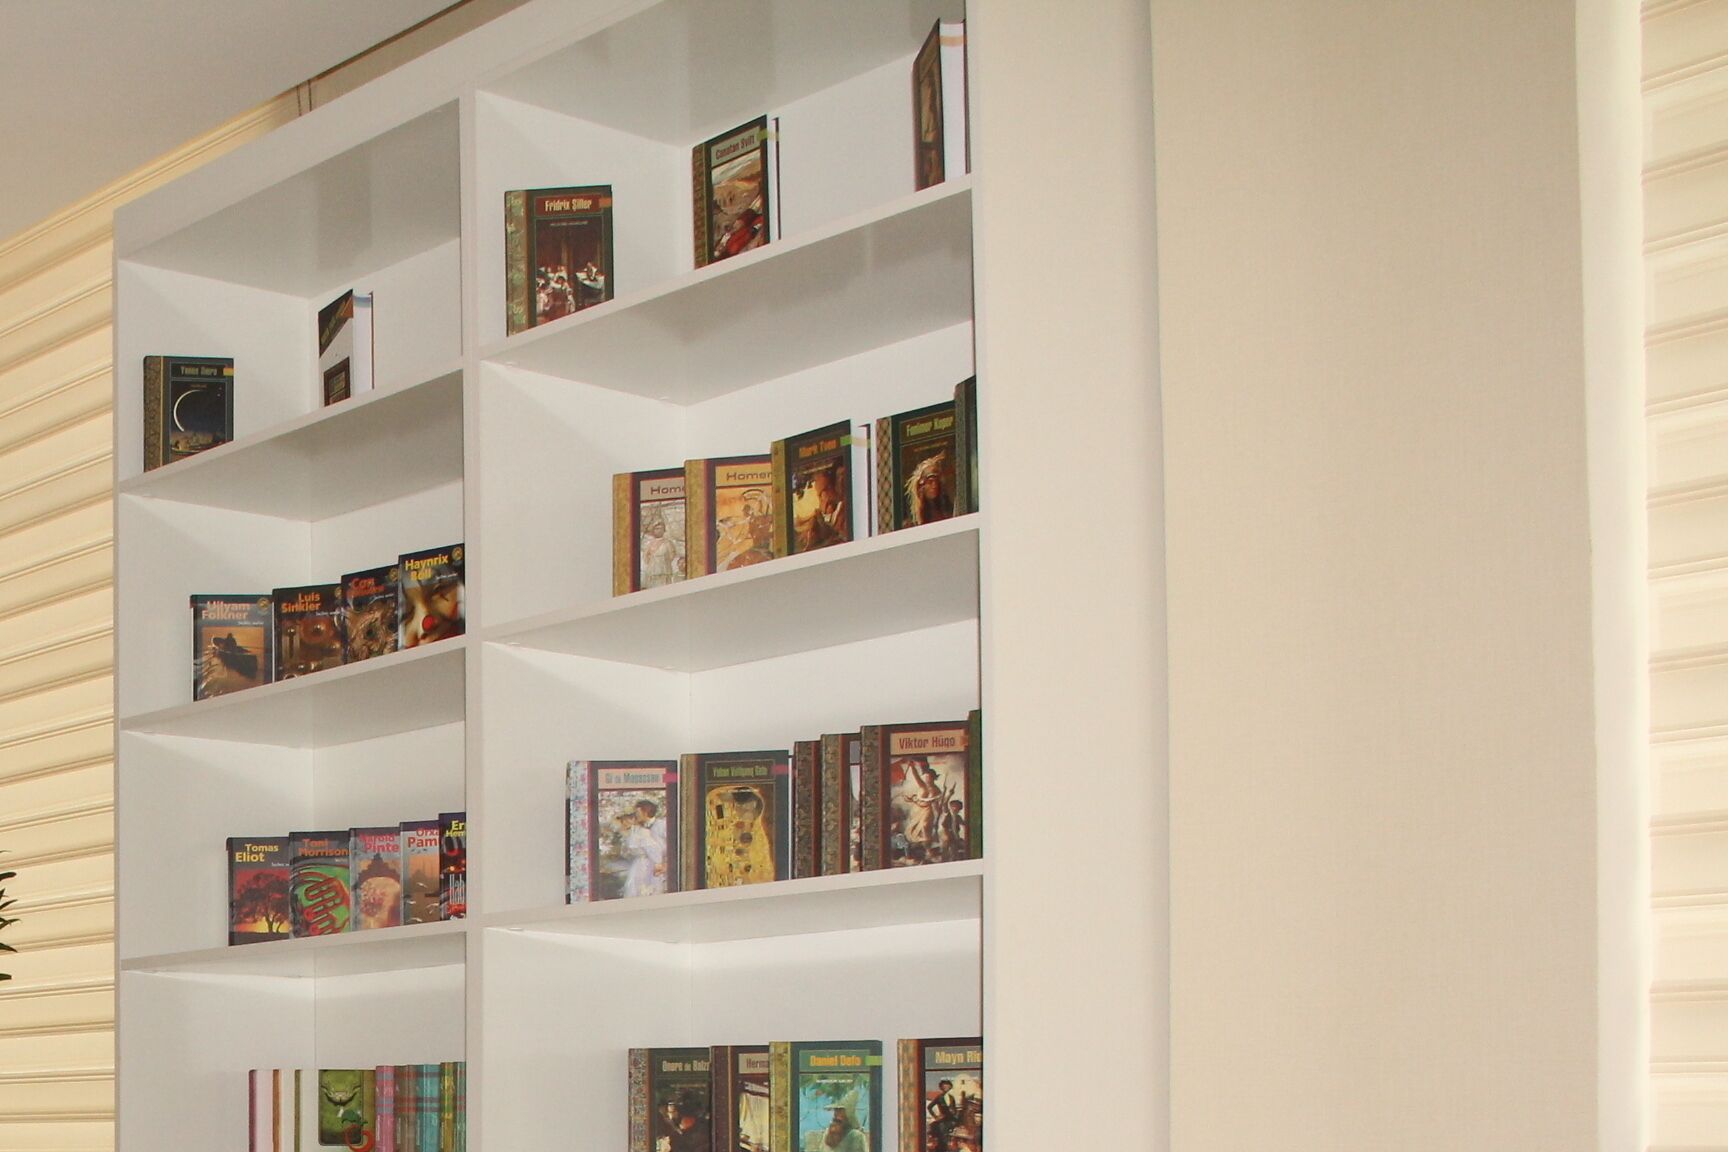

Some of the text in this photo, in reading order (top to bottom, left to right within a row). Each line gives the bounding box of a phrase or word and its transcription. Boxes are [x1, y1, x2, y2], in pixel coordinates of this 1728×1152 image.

[404, 554, 449, 571] Haynrix
[298, 592, 320, 602] Luis
[201, 608, 248, 620] Folkner
[899, 737, 929, 750] Viktor
[416, 828, 440, 837] Orxa
[244, 843, 279, 852] Tomas
[364, 841, 400, 853] Pinte
[407, 836, 439, 849] Pam
[235, 851, 265, 863] Eliot
[810, 1055, 838, 1066] Daniel
[935, 1051, 964, 1065] Mayn
